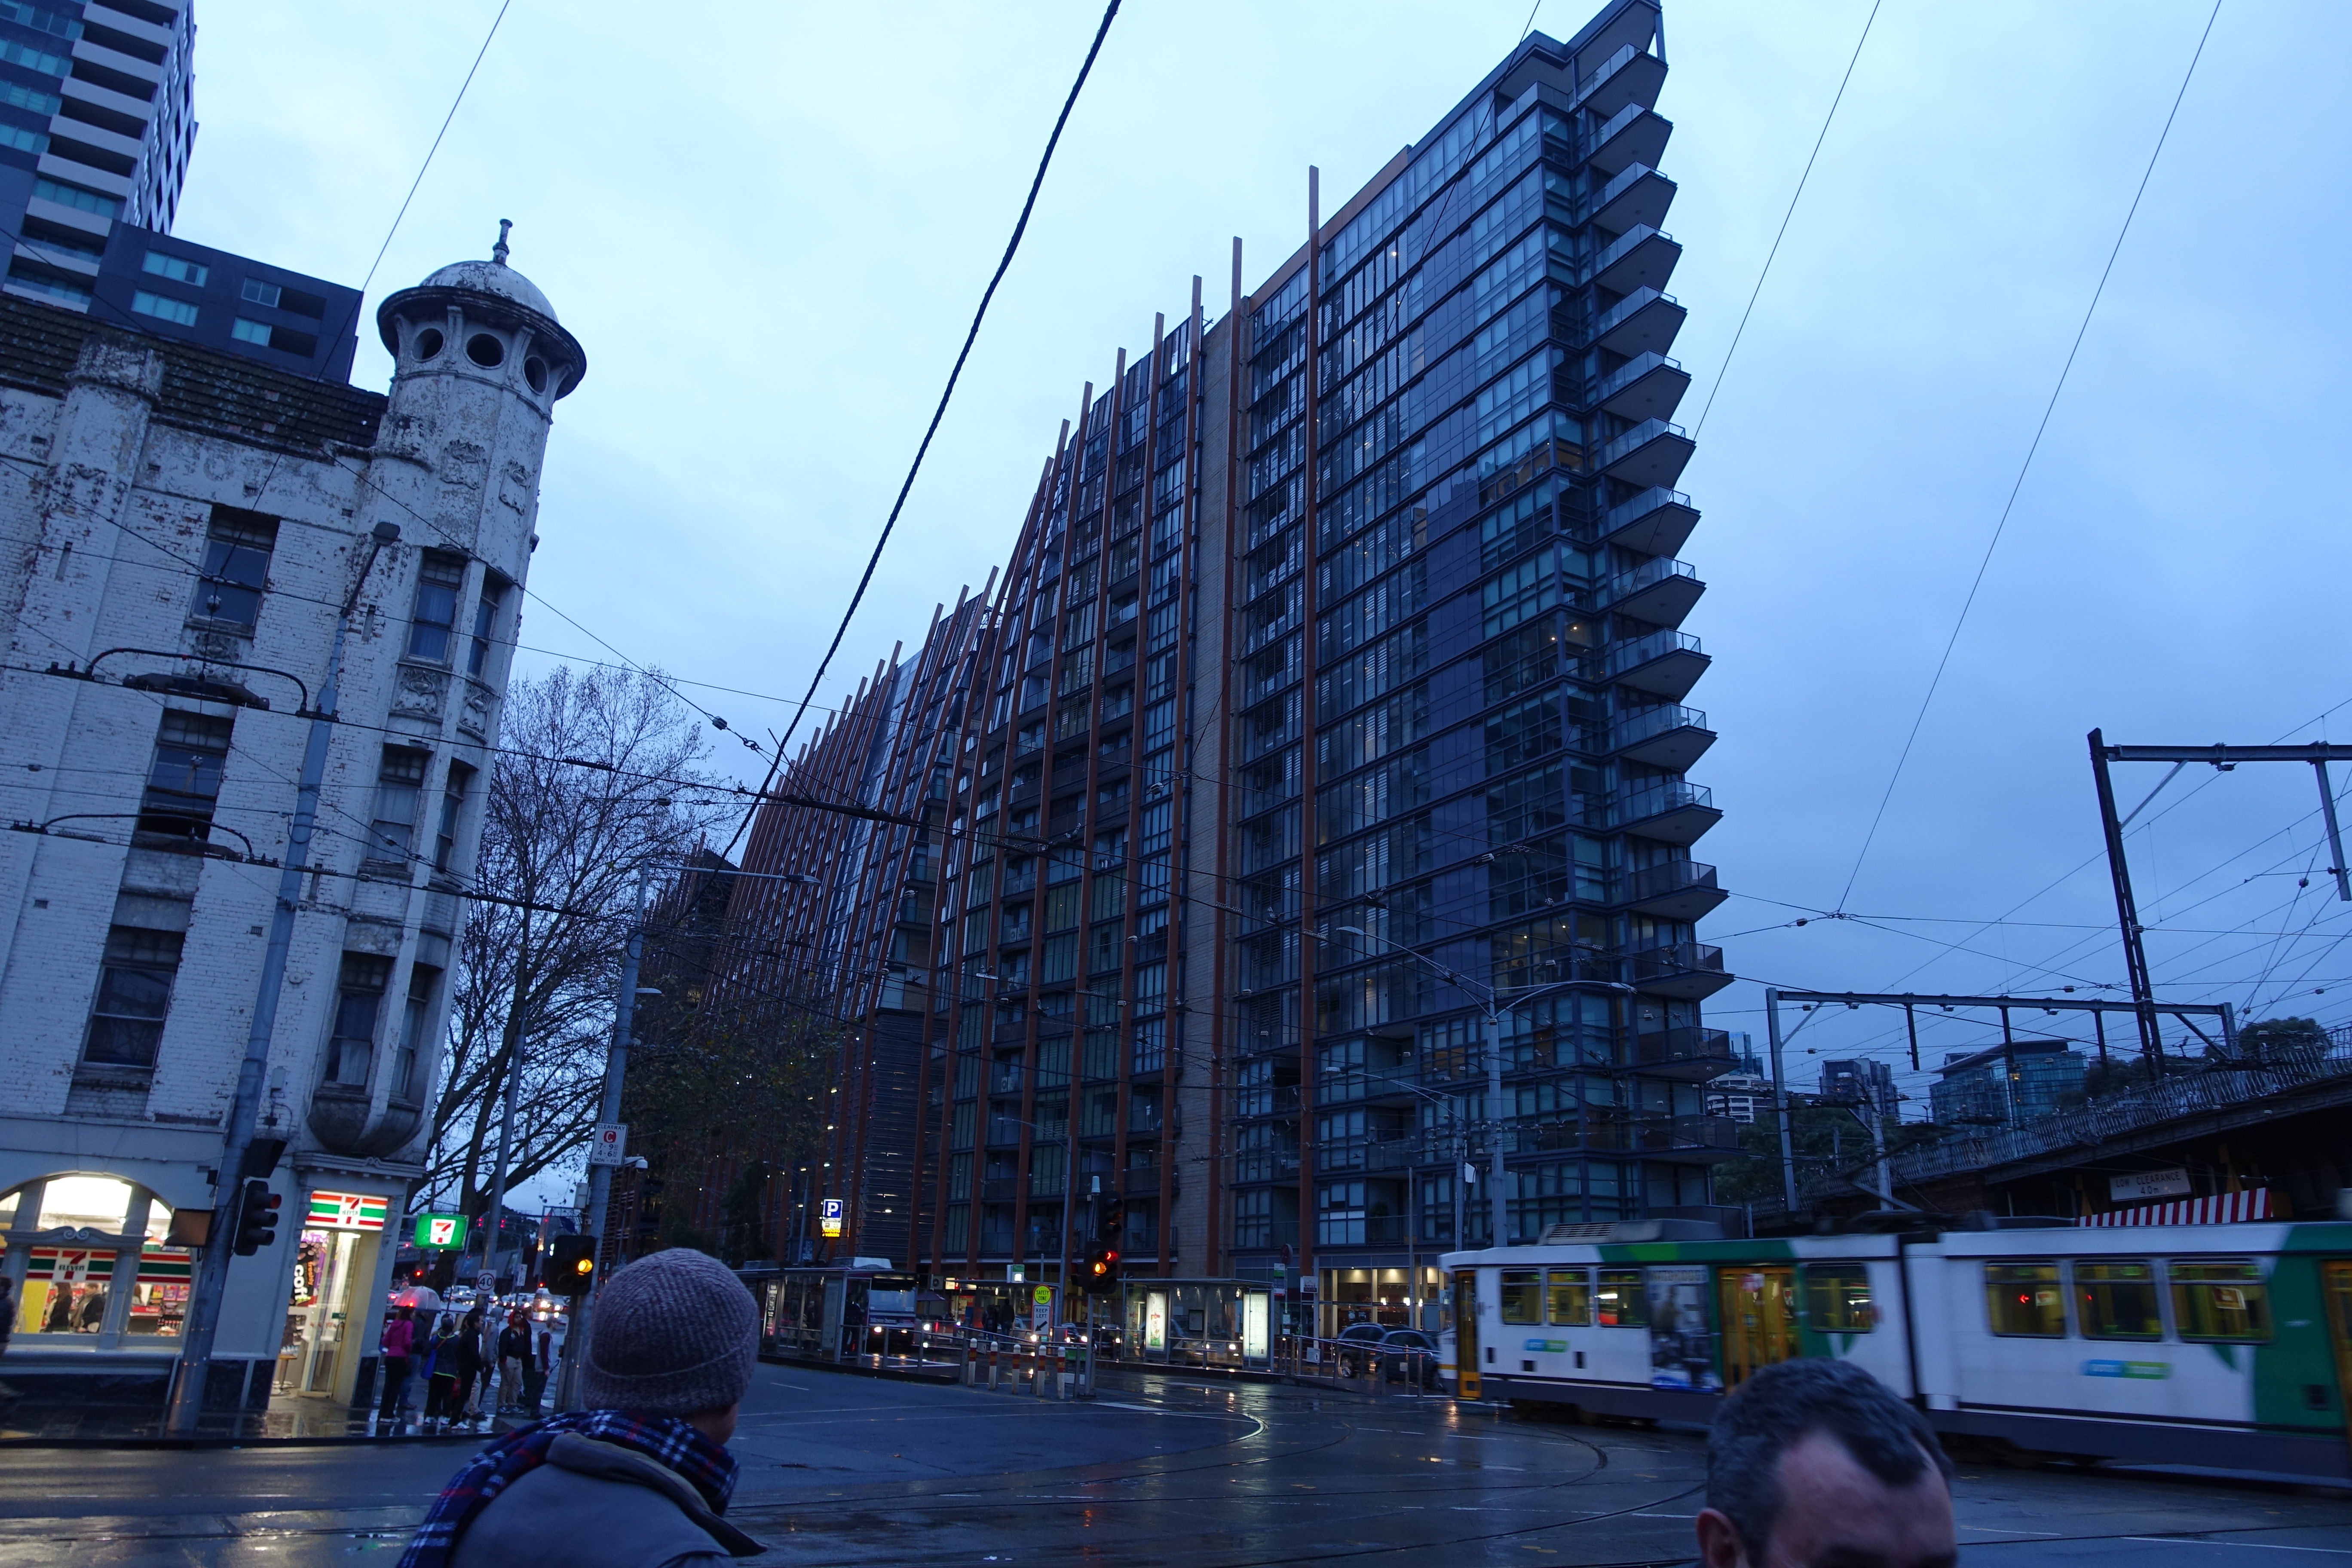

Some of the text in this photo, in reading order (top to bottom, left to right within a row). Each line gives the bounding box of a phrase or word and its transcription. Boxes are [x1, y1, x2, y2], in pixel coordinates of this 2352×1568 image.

[606, 1132, 613, 1142] C
[2116, 1172, 2181, 1188] LOW CLEARANCE
[345, 1197, 360, 1224] 7
[827, 1202, 839, 1217] P
[435, 1222, 451, 1243] 7
[62, 1251, 87, 1280] 7
[479, 1278, 493, 1286] 40
